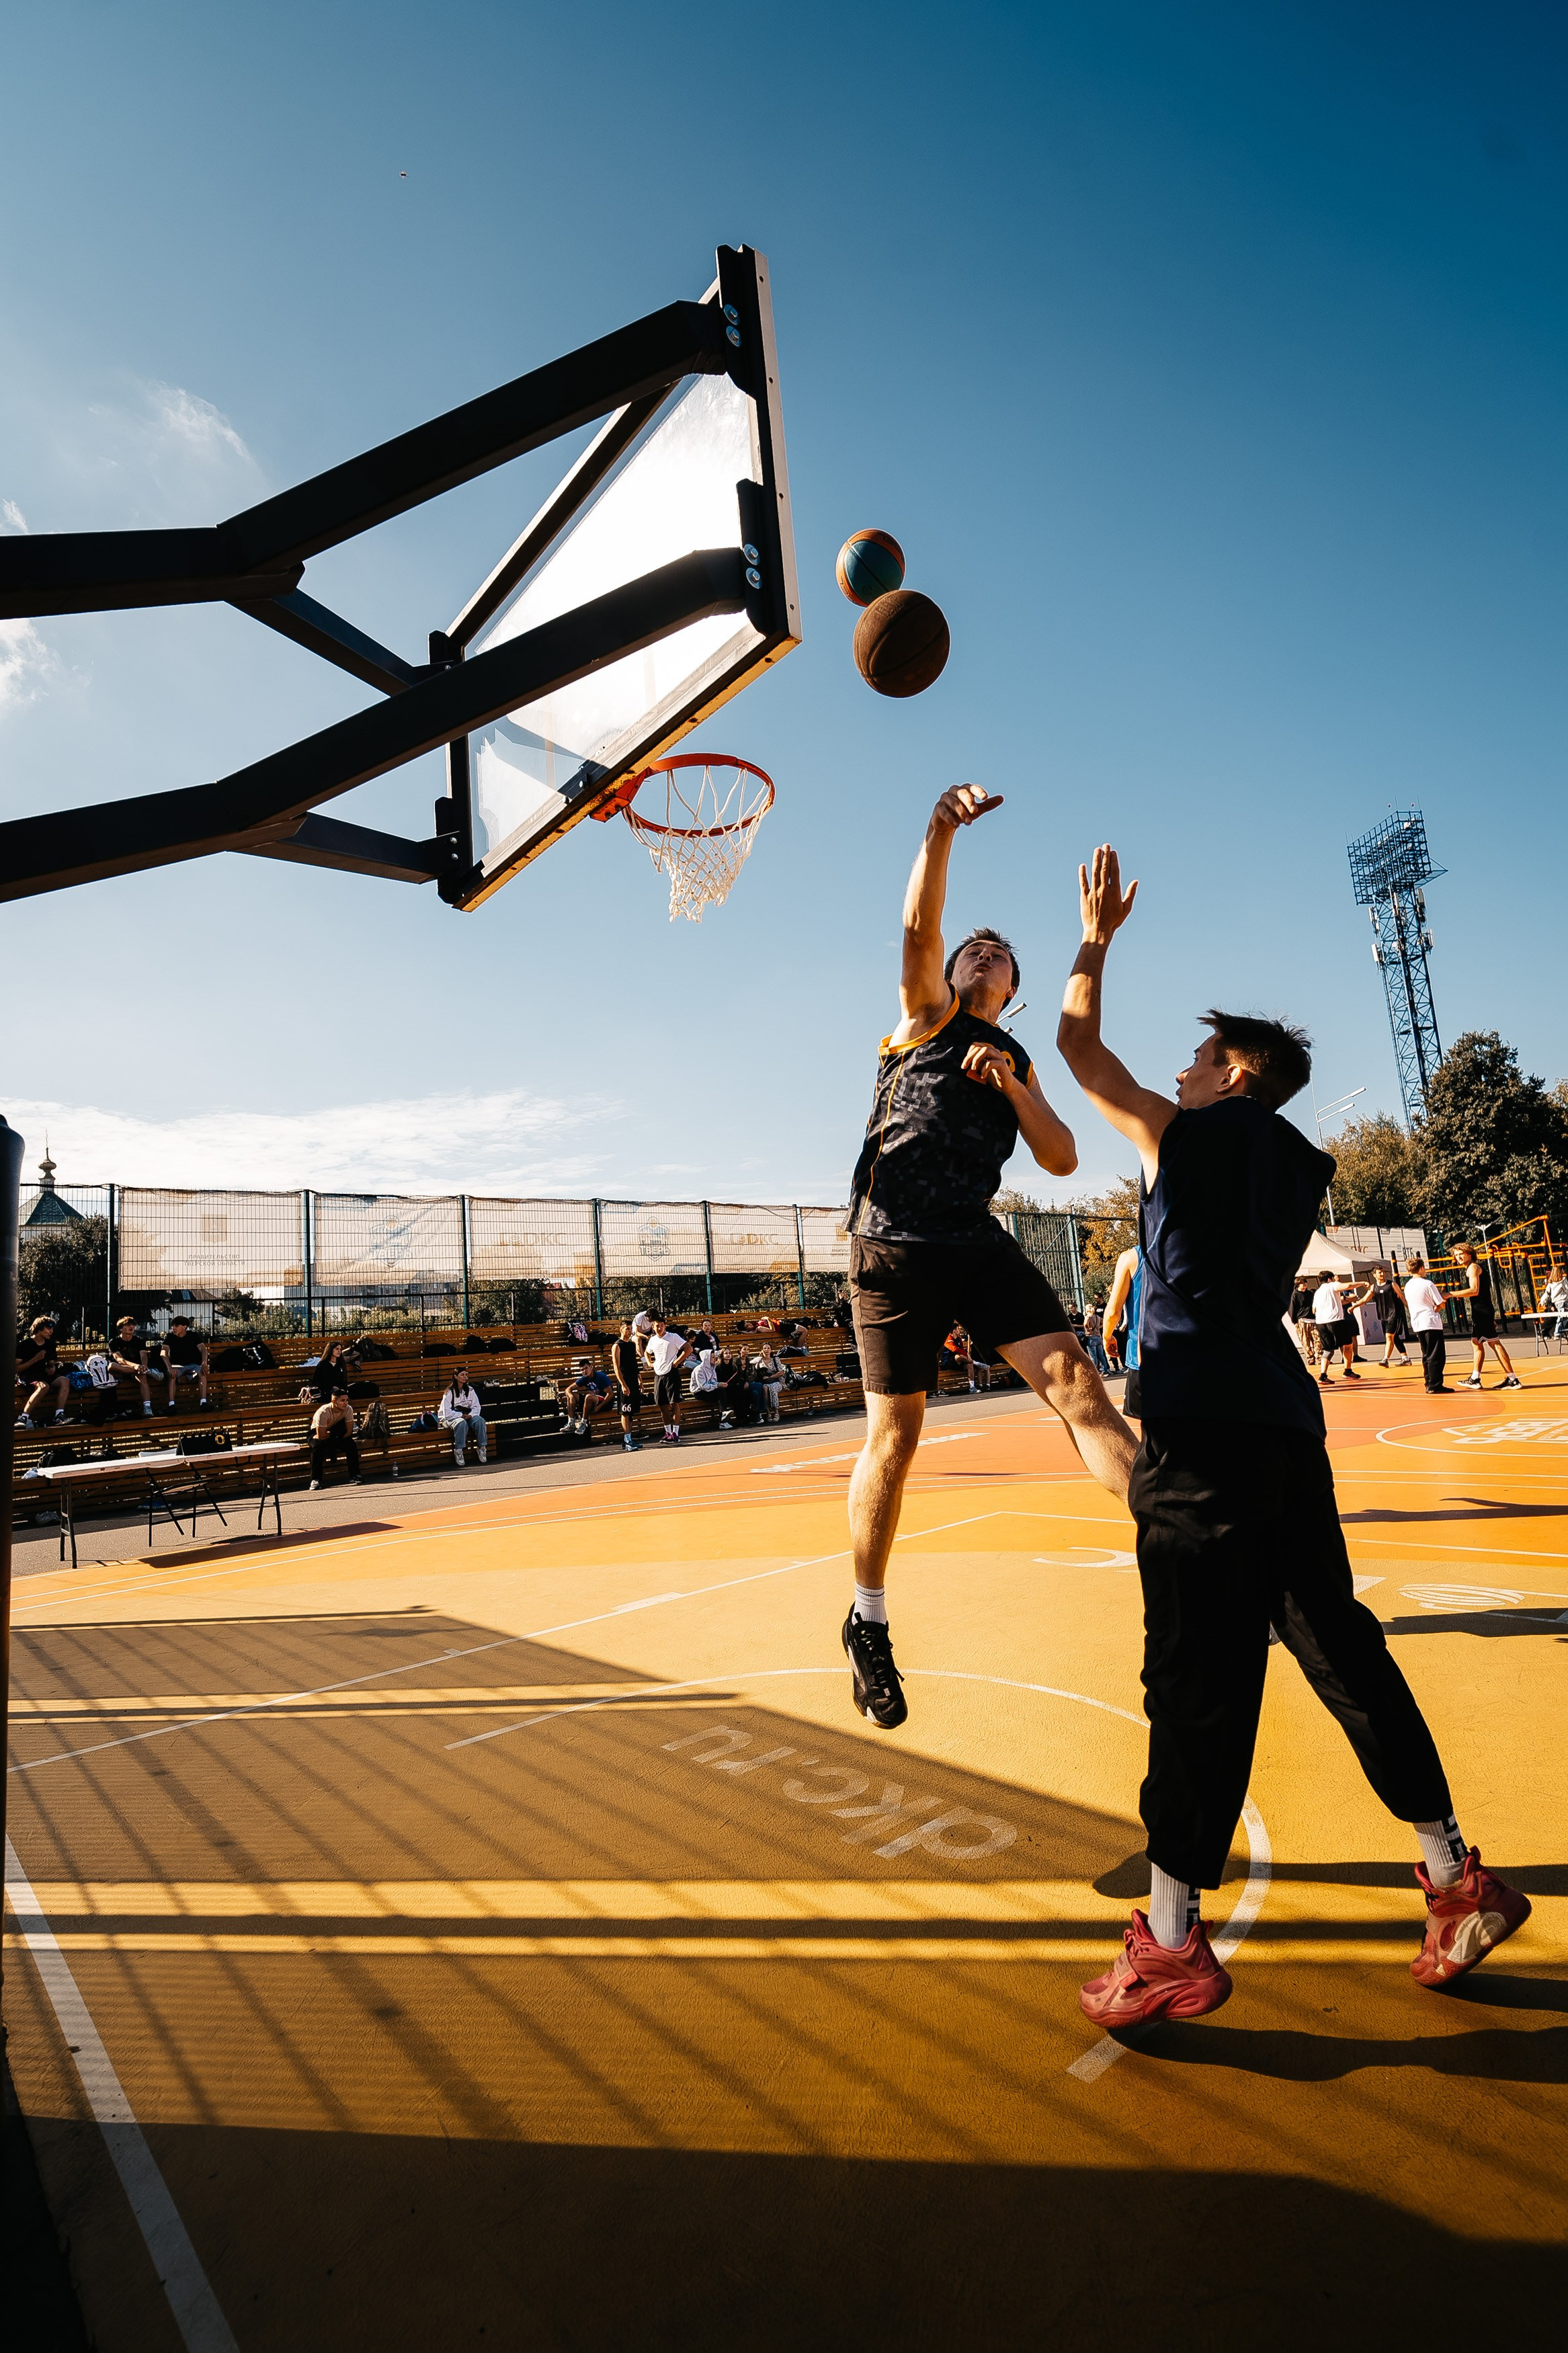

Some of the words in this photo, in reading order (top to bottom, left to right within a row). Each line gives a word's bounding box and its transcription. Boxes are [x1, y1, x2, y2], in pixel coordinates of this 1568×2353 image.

[639, 1246, 670, 1256] ТВЕРЬ
[622, 1404, 632, 1412] 66
[660, 1724, 1018, 1860] dkc.ru
